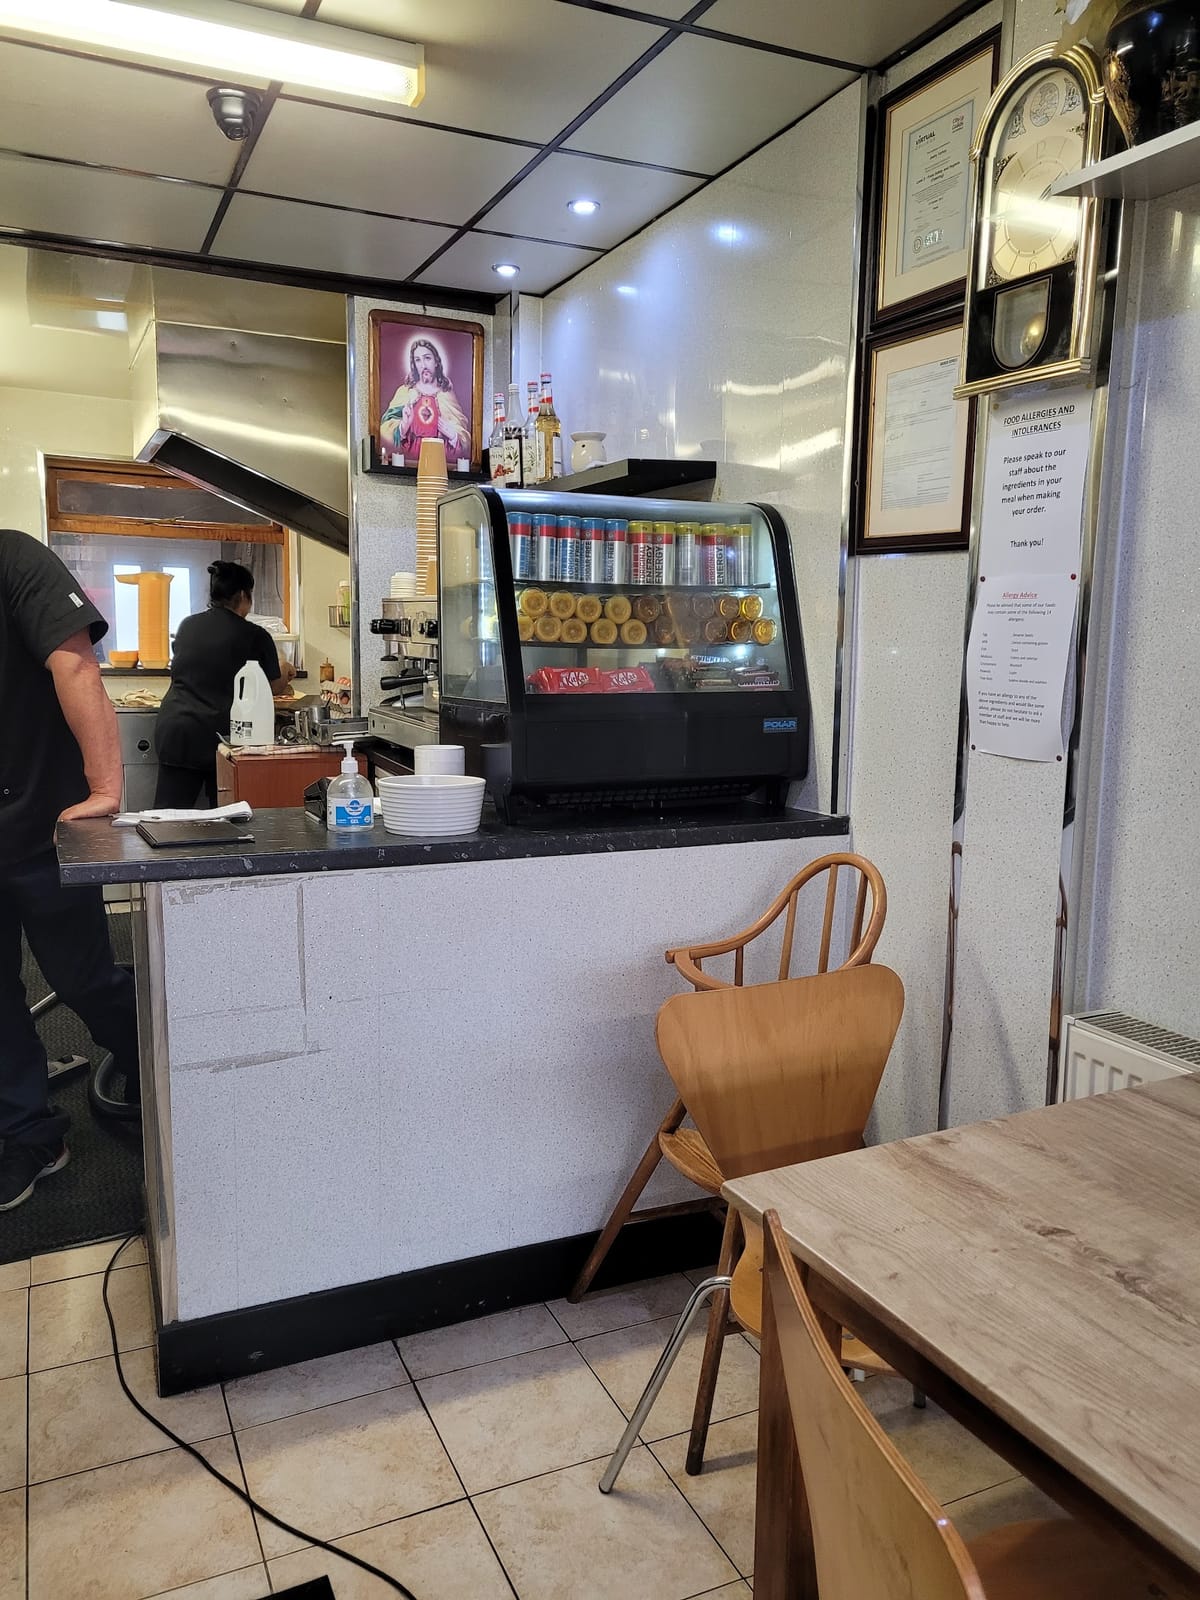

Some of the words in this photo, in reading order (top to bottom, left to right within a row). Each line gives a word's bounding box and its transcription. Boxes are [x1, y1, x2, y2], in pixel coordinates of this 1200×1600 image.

[1004, 415, 1020, 425] FOOD
[1021, 408, 1056, 421] ALLERGIES
[1058, 405, 1075, 414] AND
[1012, 421, 1062, 436] INTOLERANCES
[1004, 456, 1022, 464] Please
[1024, 450, 1043, 462] speak
[1009, 467, 1022, 476] staff
[1024, 466, 1044, 474] about
[1002, 480, 1036, 492] ingredients
[1038, 478, 1044, 486] in
[1047, 478, 1062, 486] your
[1002, 495, 1016, 504] meal
[1018, 494, 1034, 502] when
[1036, 490, 1061, 499] making
[1012, 509, 1026, 517] your
[1026, 506, 1046, 514] order.
[1010, 540, 1028, 548] Thank
[1030, 538, 1044, 548] you!
[655, 546, 663, 584] ENERGY
